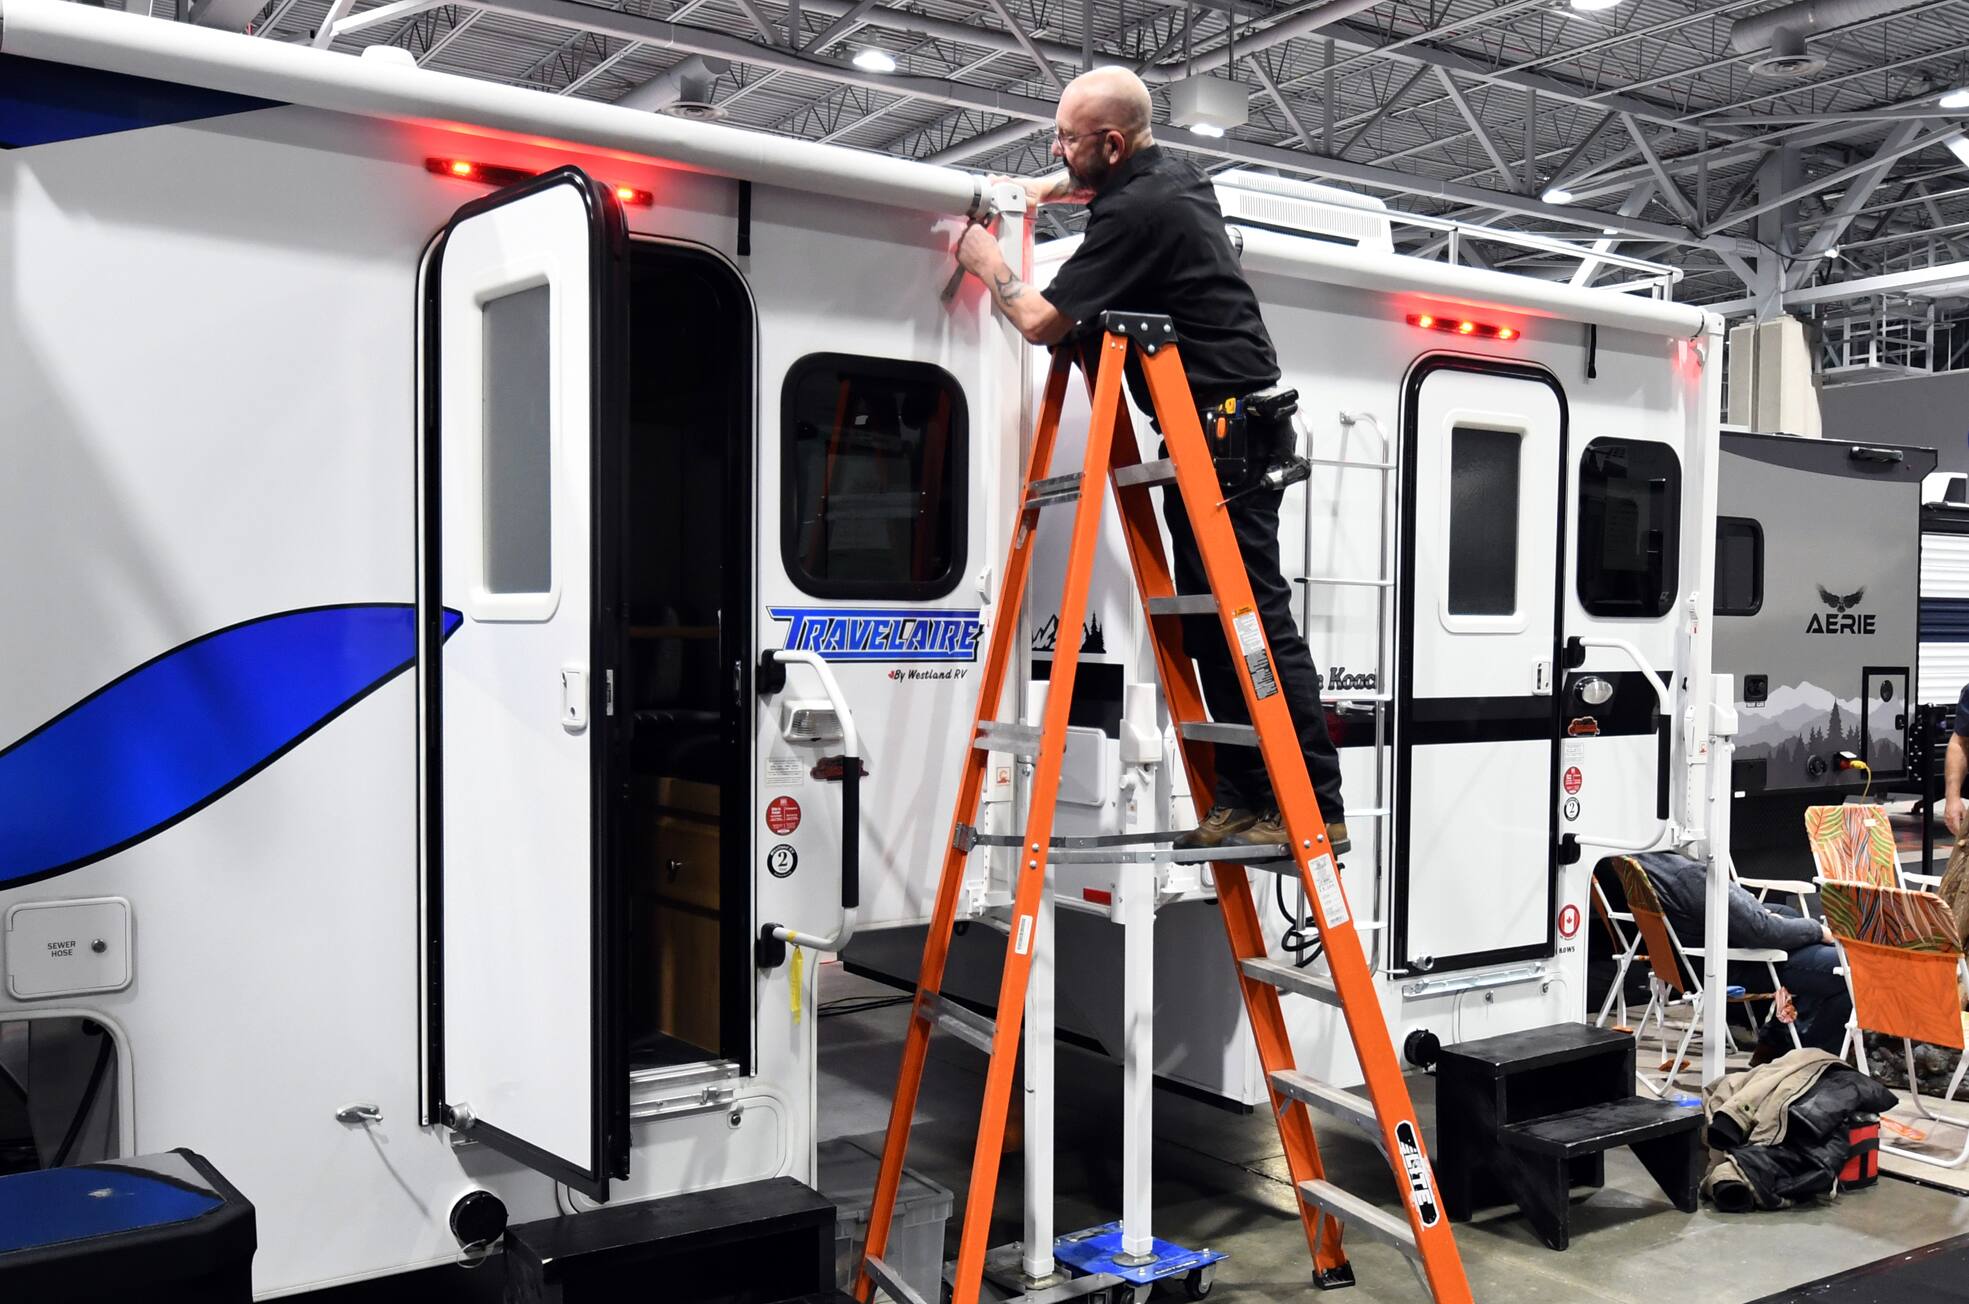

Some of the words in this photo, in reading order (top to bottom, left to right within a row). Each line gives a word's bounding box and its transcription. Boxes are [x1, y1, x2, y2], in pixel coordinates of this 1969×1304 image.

[1805, 613, 1877, 635] AERIE
[766, 606, 984, 662] TRAVELAIRE
[893, 669, 906, 683] By
[907, 668, 952, 680] Westland
[954, 668, 968, 679] RV
[1328, 667, 1376, 691] Koac
[1569, 802, 1575, 813] 2
[778, 851, 788, 867] 2
[47, 941, 76, 950] SEWER
[51, 949, 73, 957] HOSE
